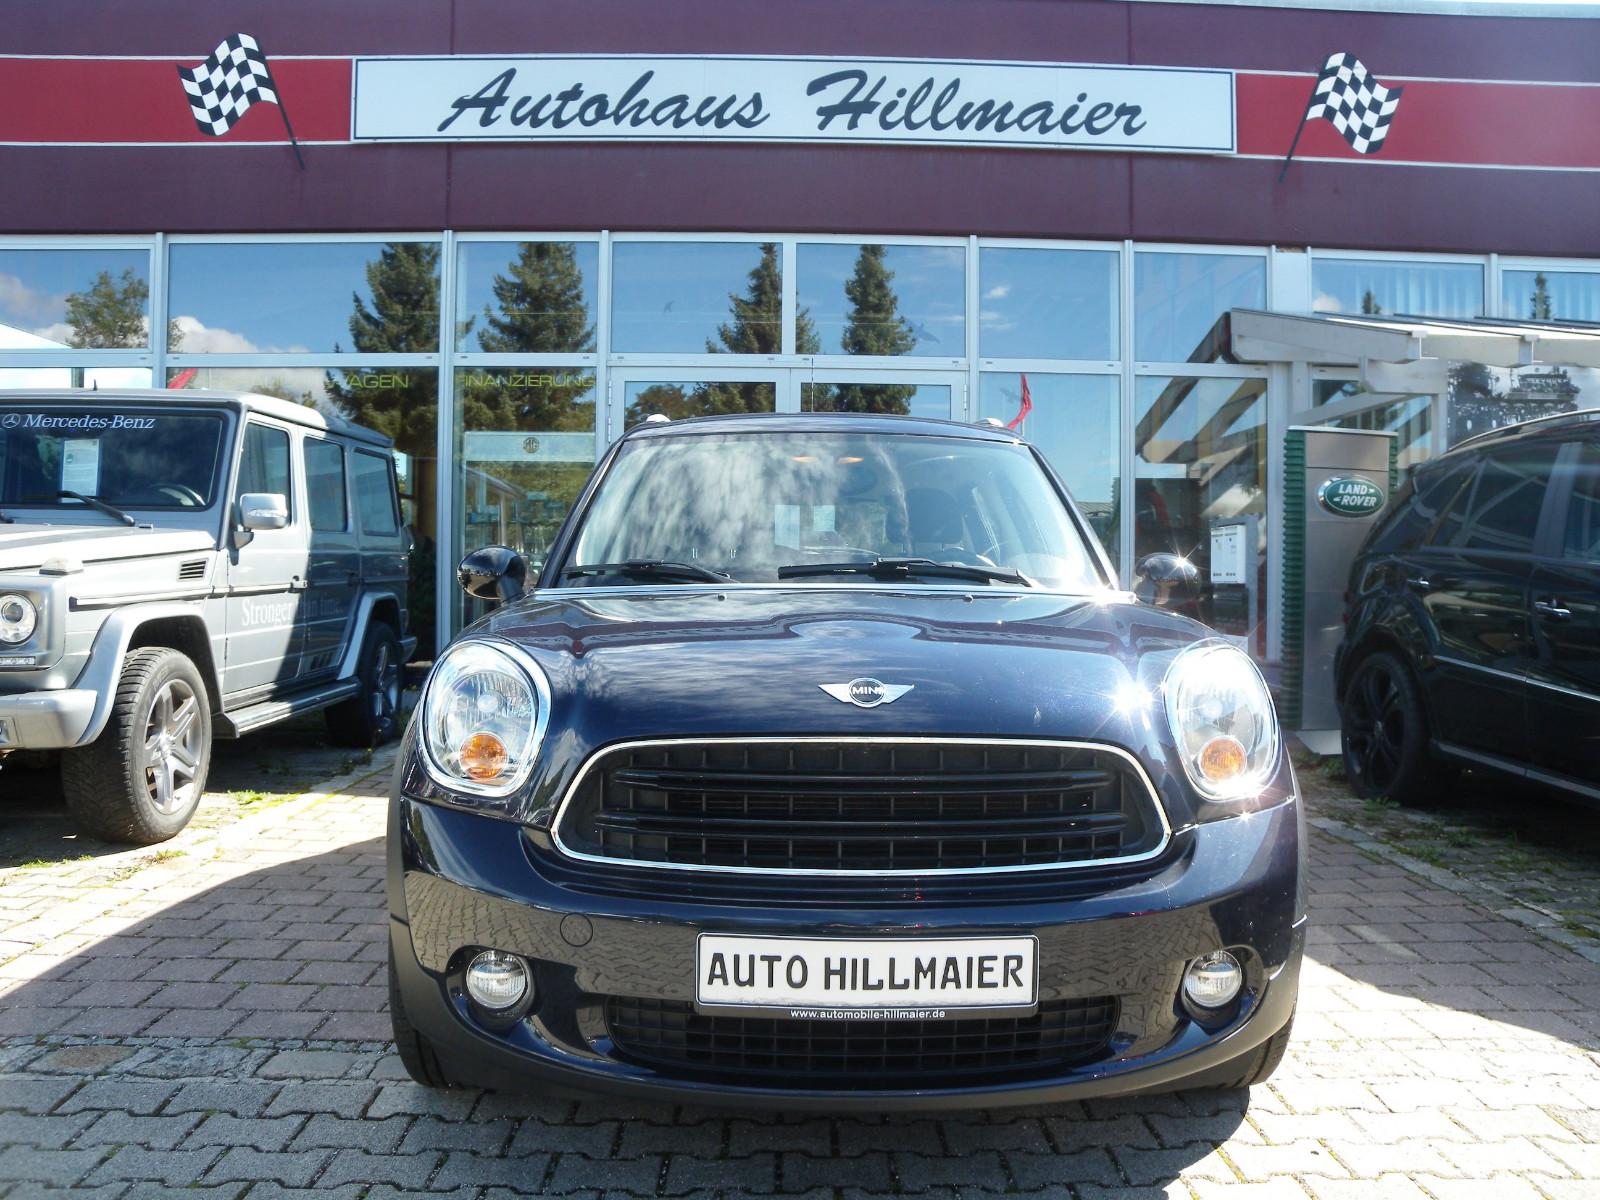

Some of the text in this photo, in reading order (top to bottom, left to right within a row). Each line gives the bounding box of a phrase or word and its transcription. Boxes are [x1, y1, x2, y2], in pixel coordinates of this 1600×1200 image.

[437, 67, 1147, 136] Autohaus Hillmaier
[23, 413, 156, 429] Mercedes-Benz
[1338, 484, 1368, 495] LAND
[1341, 495, 1377, 507] ROVER
[241, 599, 293, 626] Stronger
[852, 686, 886, 695] MINI
[707, 953, 1024, 991] AUTO HILLMAIER
[790, 1009, 946, 1020] www.automobile-hillmaier.de
